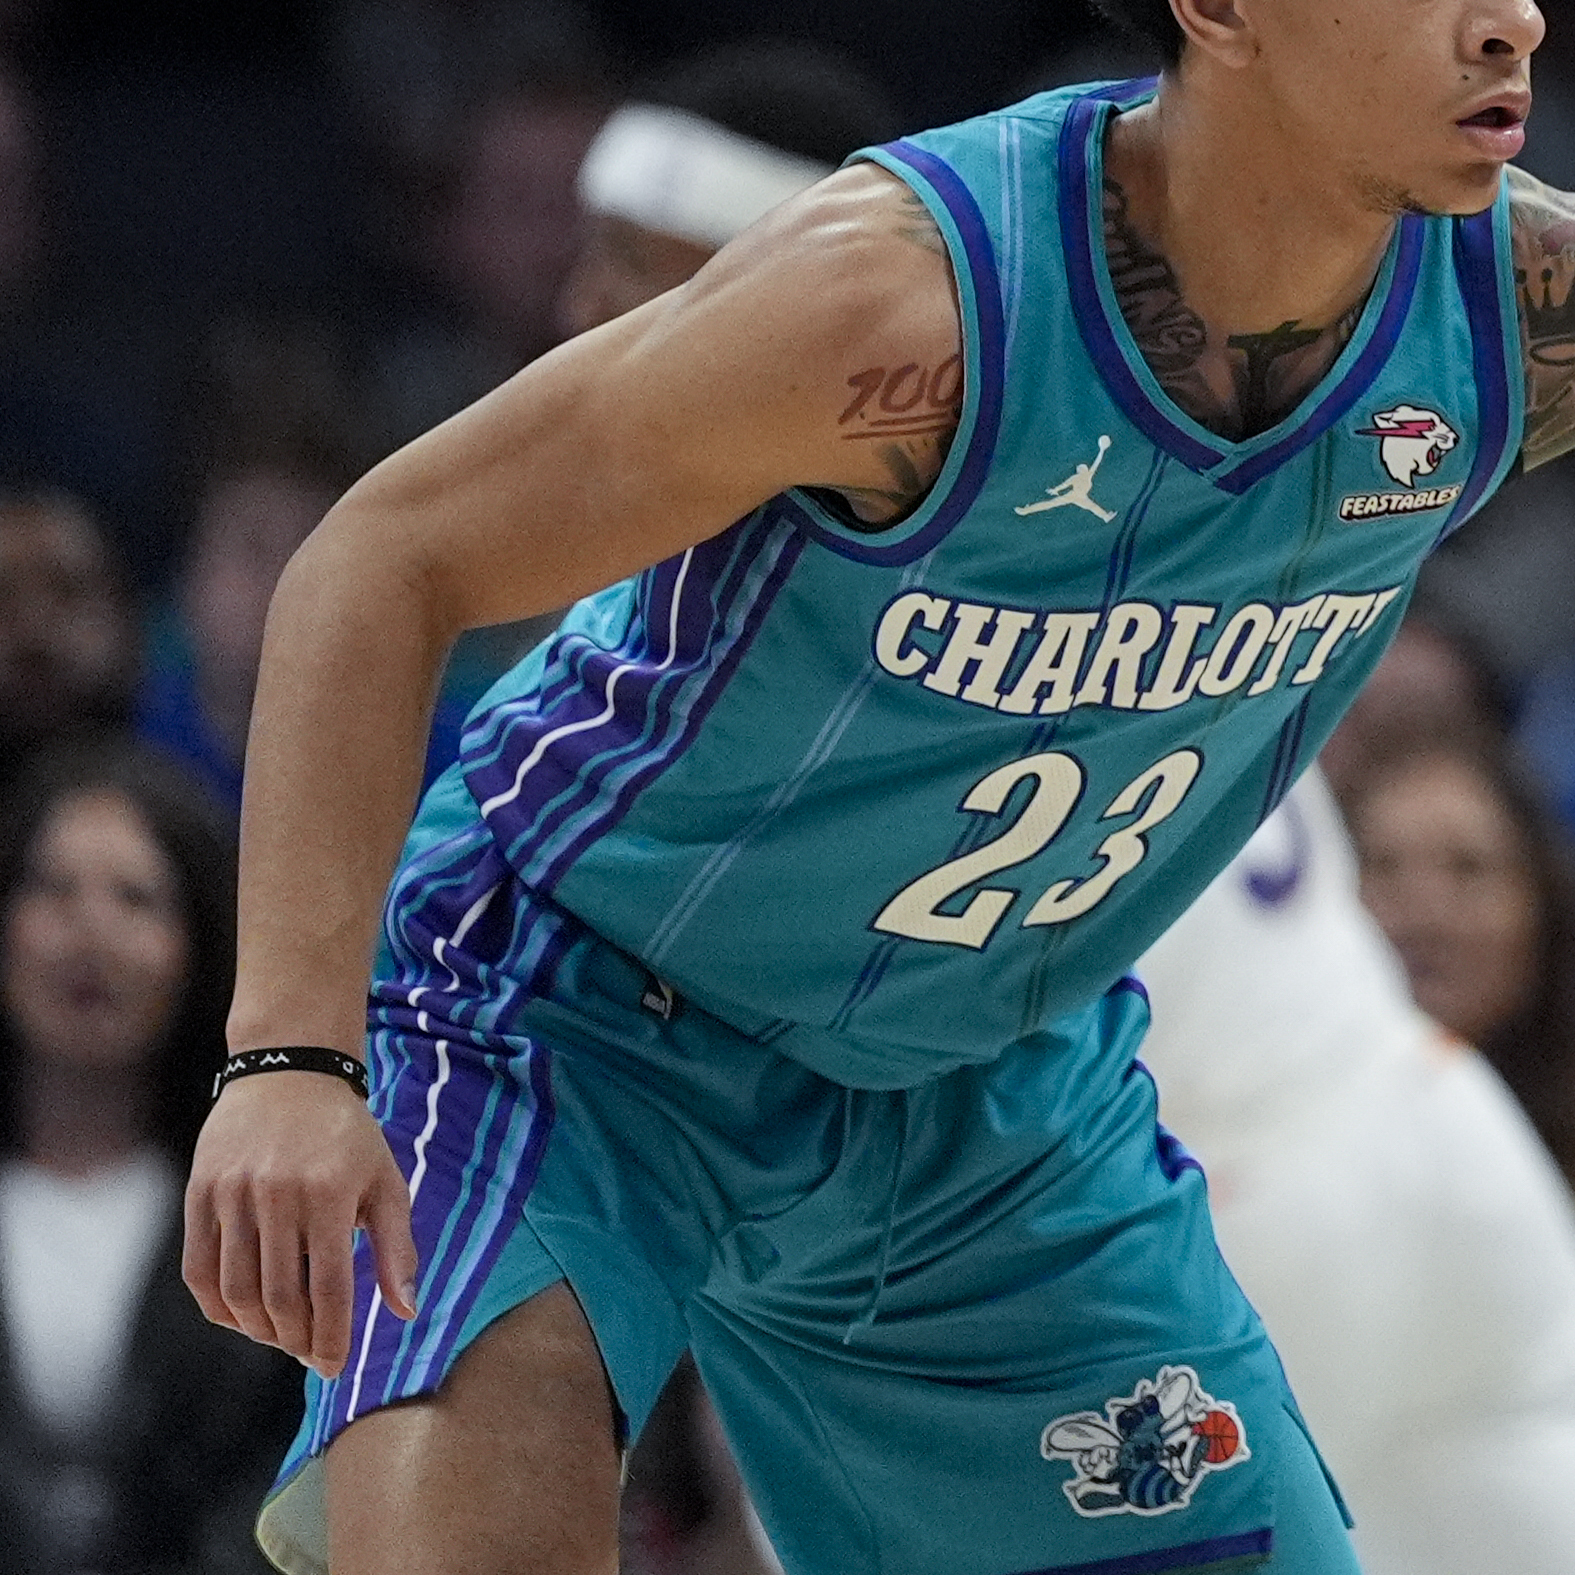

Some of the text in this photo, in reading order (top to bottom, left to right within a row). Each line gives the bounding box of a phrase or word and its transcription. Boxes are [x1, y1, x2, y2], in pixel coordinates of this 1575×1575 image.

[837, 354, 964, 425] 100
[1341, 485, 1461, 518] FEASTABLES
[872, 748, 1204, 951] 23
